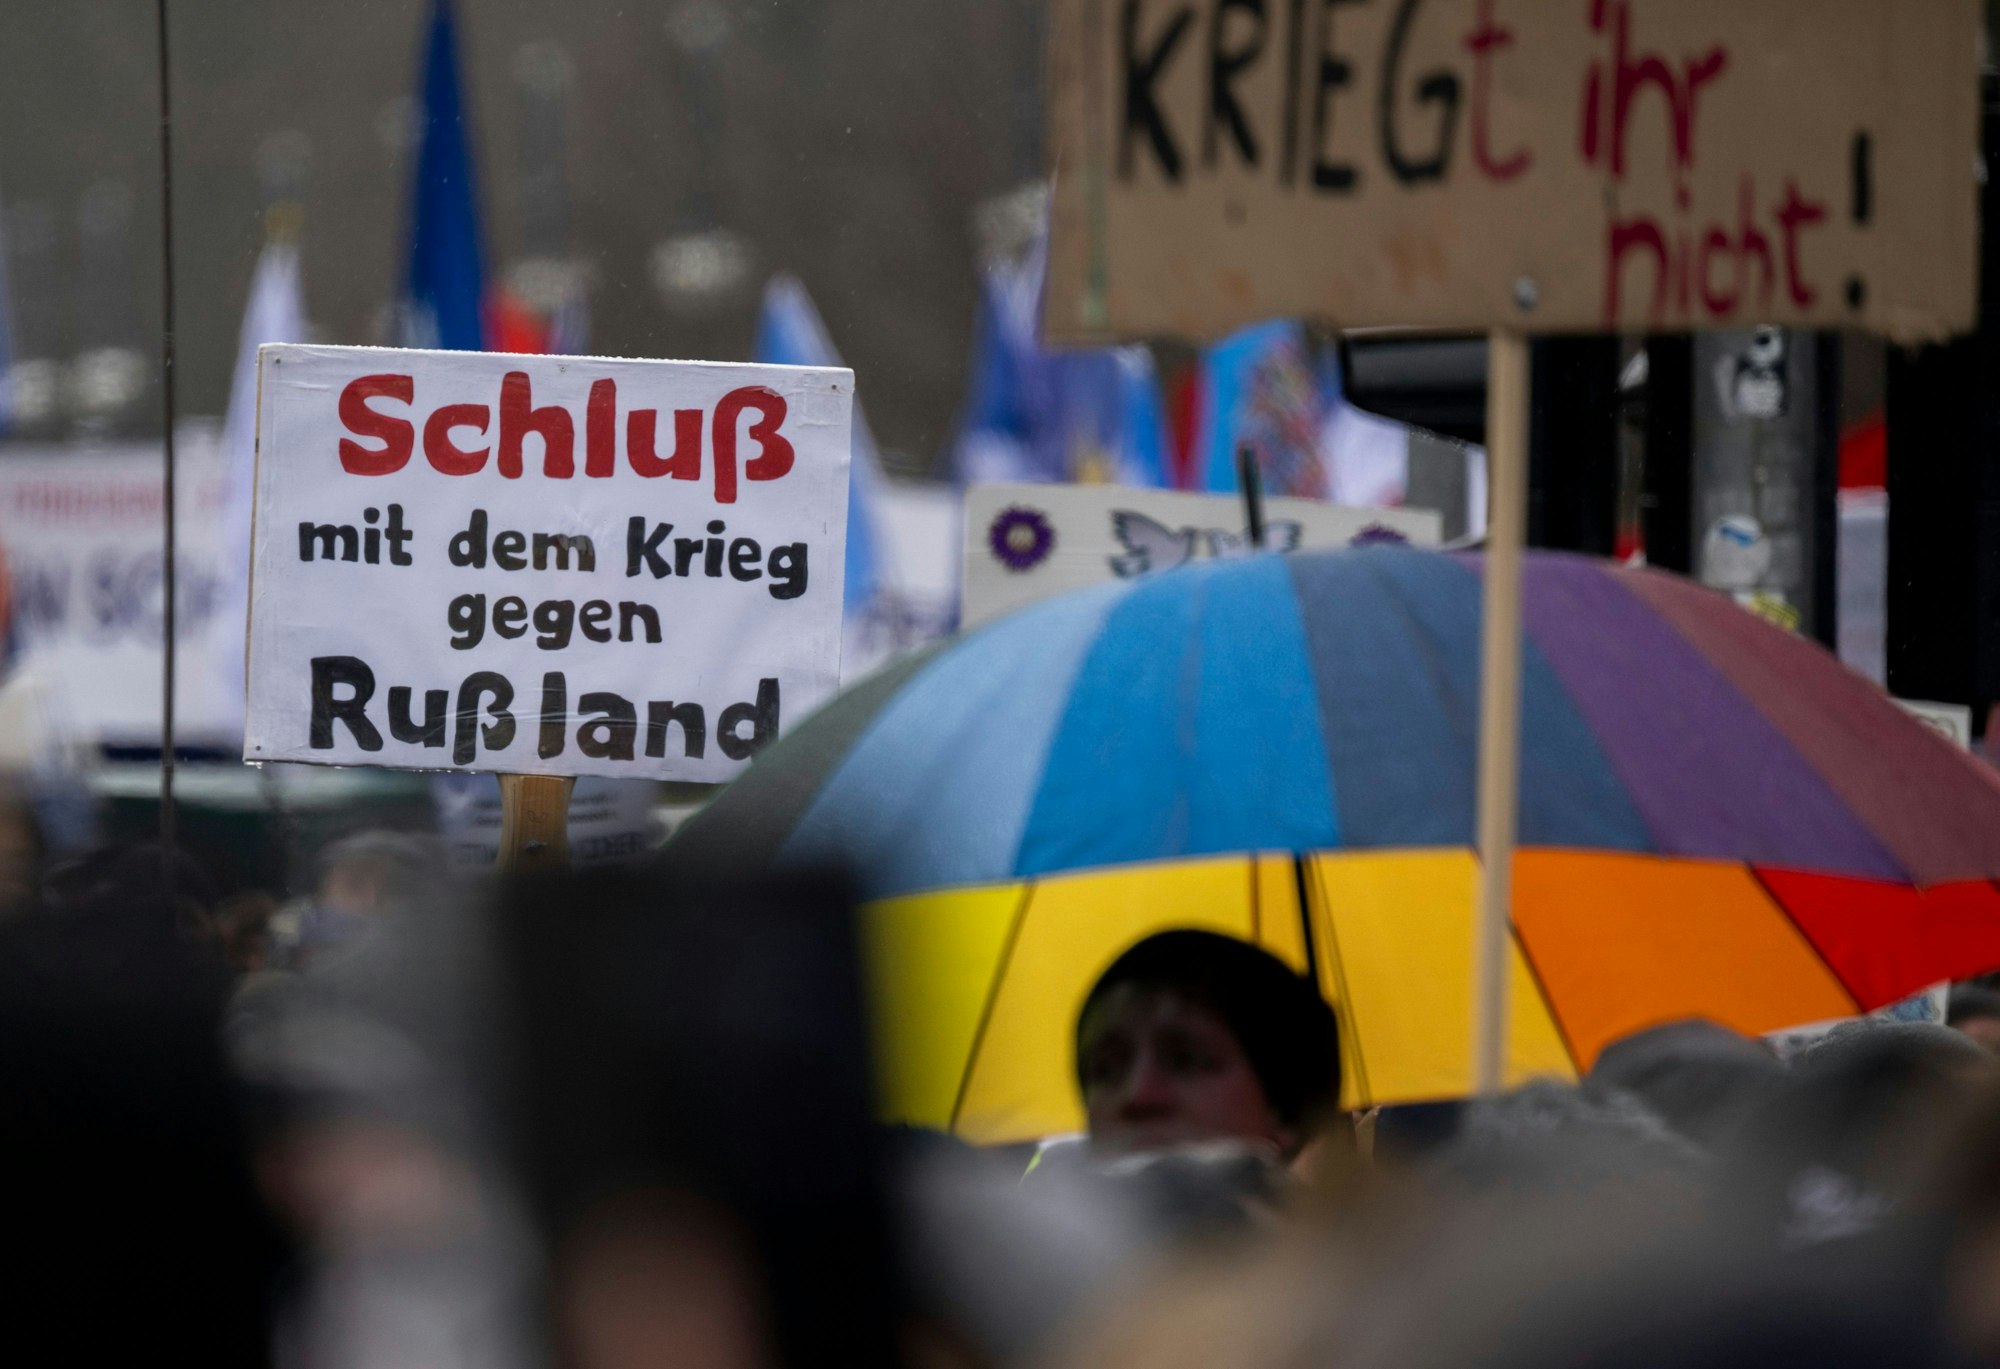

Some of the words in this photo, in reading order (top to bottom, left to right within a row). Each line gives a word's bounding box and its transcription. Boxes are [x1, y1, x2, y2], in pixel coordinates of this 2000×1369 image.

[1116, 0, 1534, 193] KRIEGt
[1576, 0, 1728, 180] ihr
[338, 371, 795, 504] Schluß
[299, 504, 413, 567] mit
[448, 509, 596, 573] dem
[626, 516, 808, 600] Krieg
[447, 593, 663, 651] gegen
[309, 655, 780, 765] Rußland
